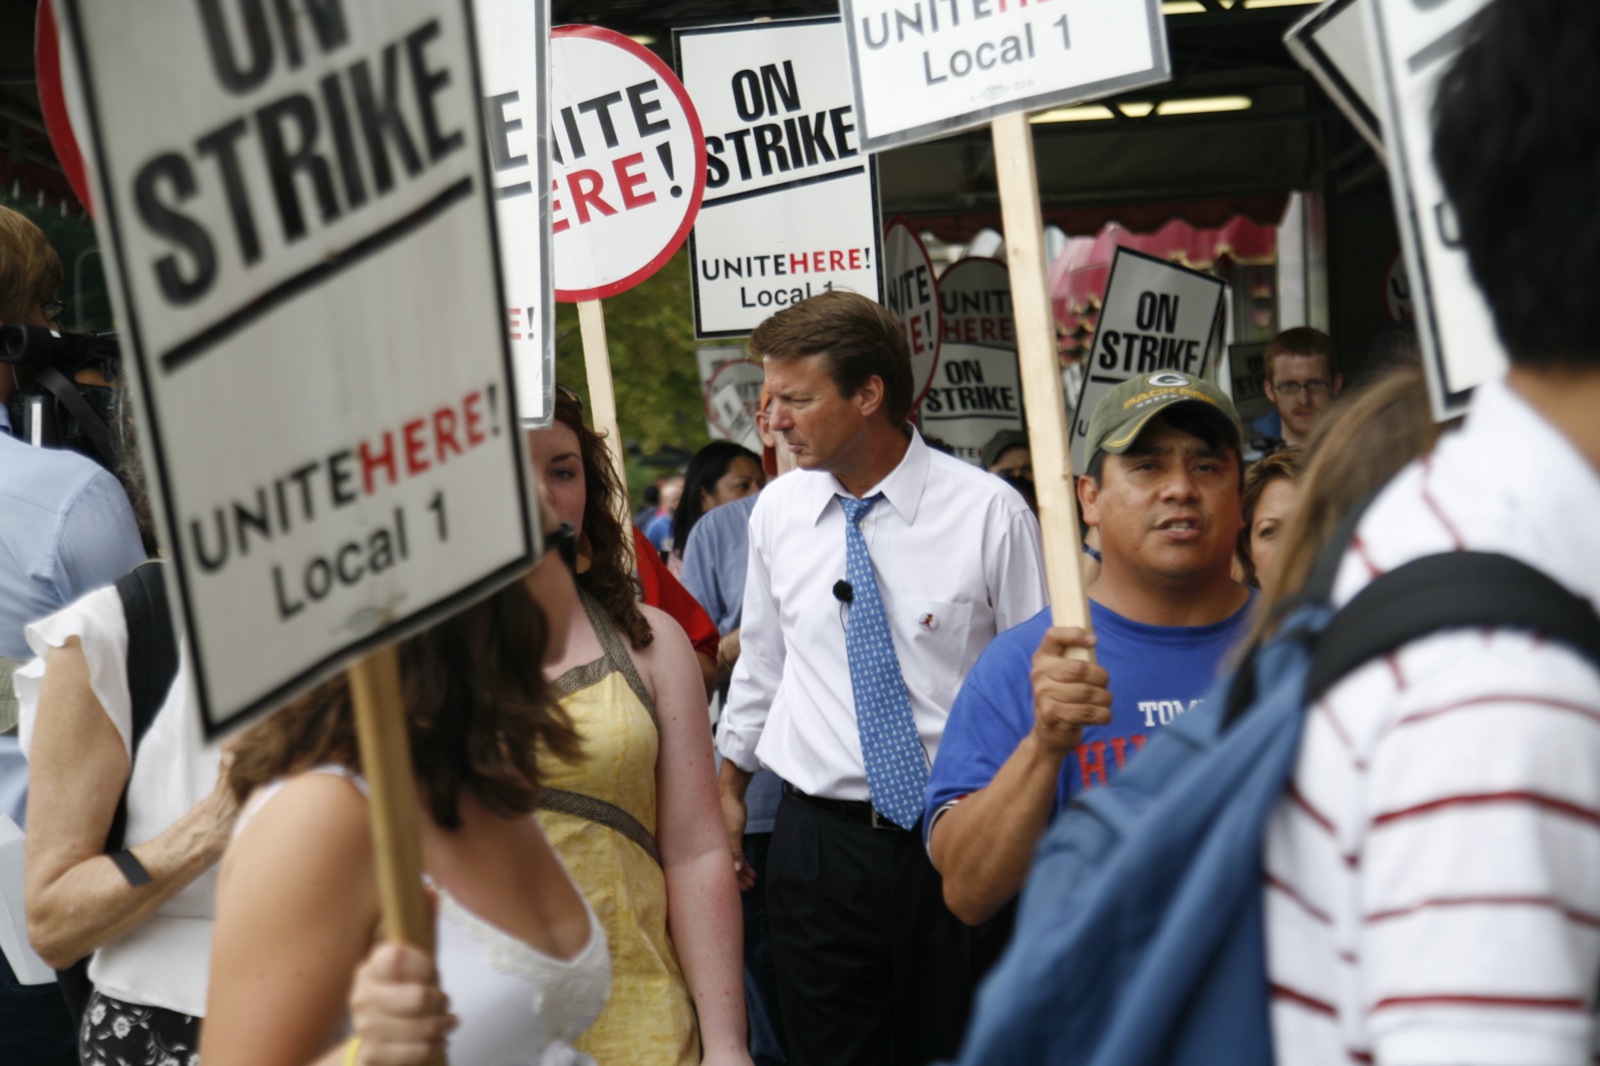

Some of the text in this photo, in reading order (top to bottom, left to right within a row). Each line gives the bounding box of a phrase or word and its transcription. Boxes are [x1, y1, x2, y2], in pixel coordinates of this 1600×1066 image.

[923, 14, 1071, 86] Local 1
[731, 60, 801, 123] ON
[552, 78, 671, 165] ITE
[706, 105, 859, 189] STRIKE
[133, 18, 466, 308] STRIKE
[552, 141, 683, 234] RE!
[702, 247, 871, 281] UNITEHERE!
[741, 282, 811, 308] Local
[941, 289, 1012, 315] UNIT
[1136, 290, 1179, 334] ON
[944, 360, 984, 386] ON
[1098, 330, 1200, 375] STRIKE
[926, 386, 1016, 412] STRIKE
[189, 385, 503, 573] UNITEHERE!
[273, 508, 409, 621] Local
[429, 492, 450, 543] 1
[1138, 698, 1205, 727] TO
